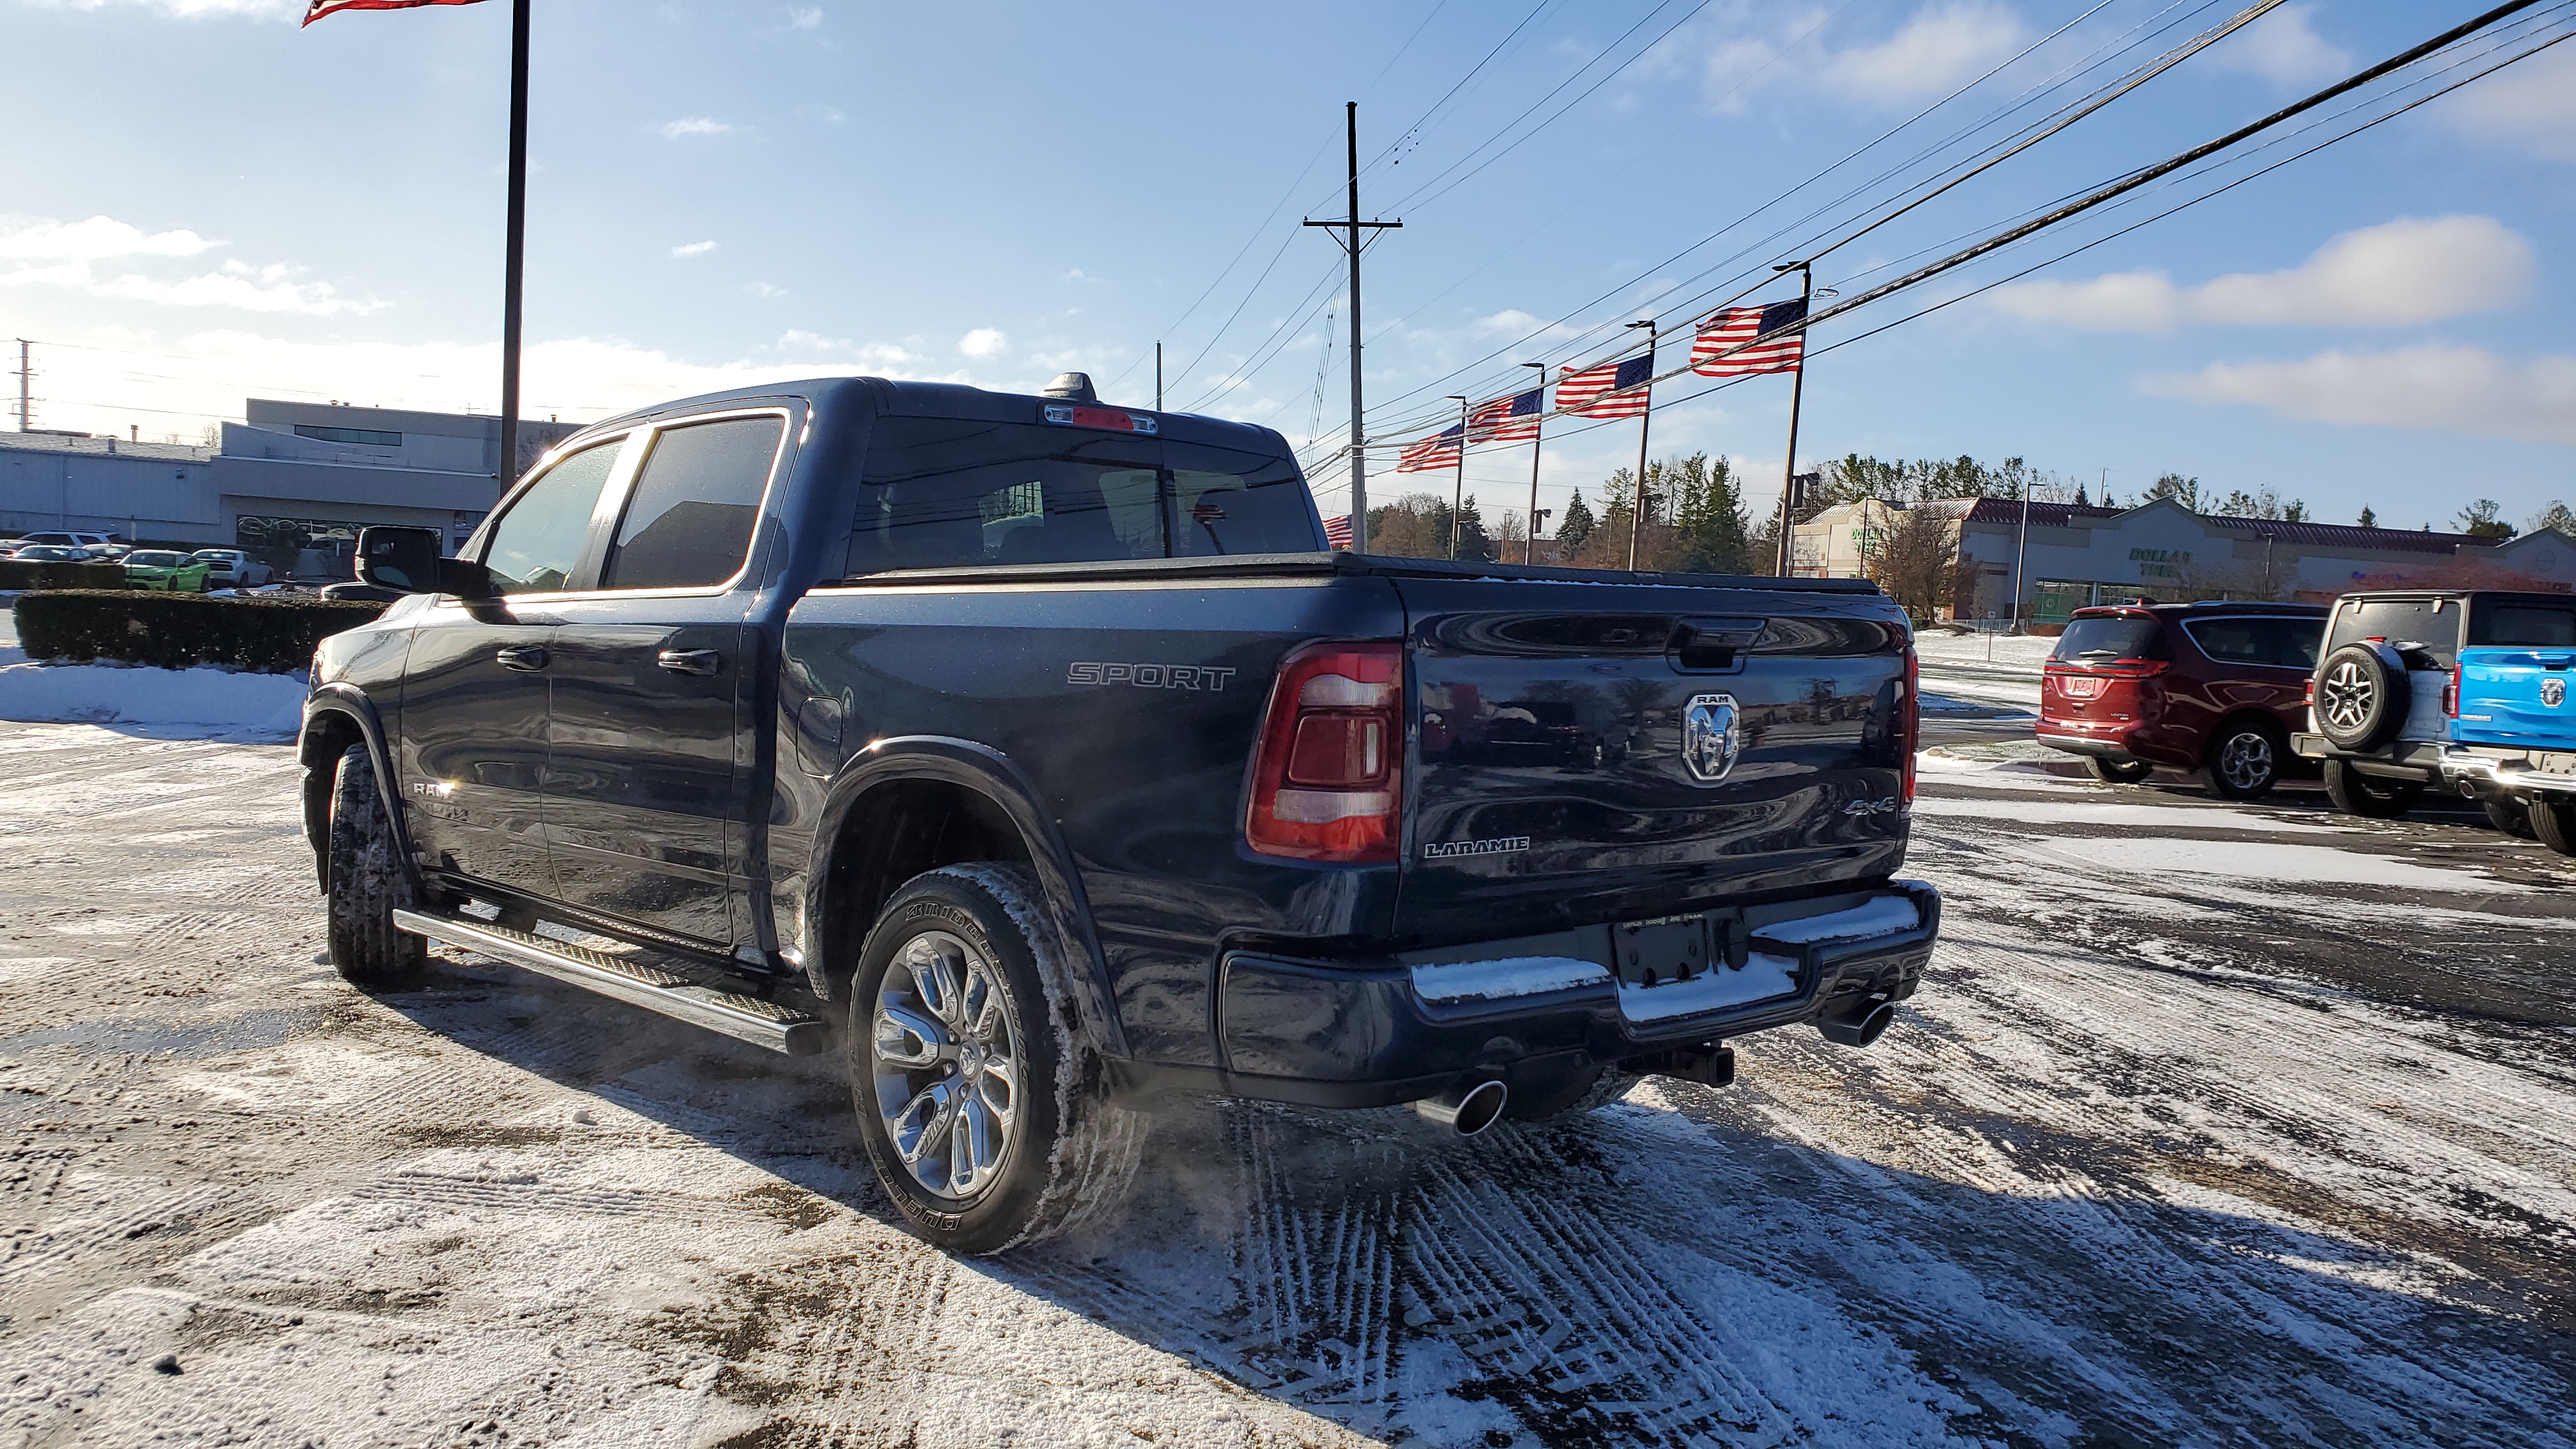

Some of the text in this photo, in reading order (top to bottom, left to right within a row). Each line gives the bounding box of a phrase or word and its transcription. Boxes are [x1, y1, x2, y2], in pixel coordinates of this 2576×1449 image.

[1067, 661, 1236, 691] SPORT
[1424, 836, 1530, 859] LARAMIE
[906, 902, 1029, 1095] BRIDGESTONE
[866, 1138, 962, 1231] DUELER
